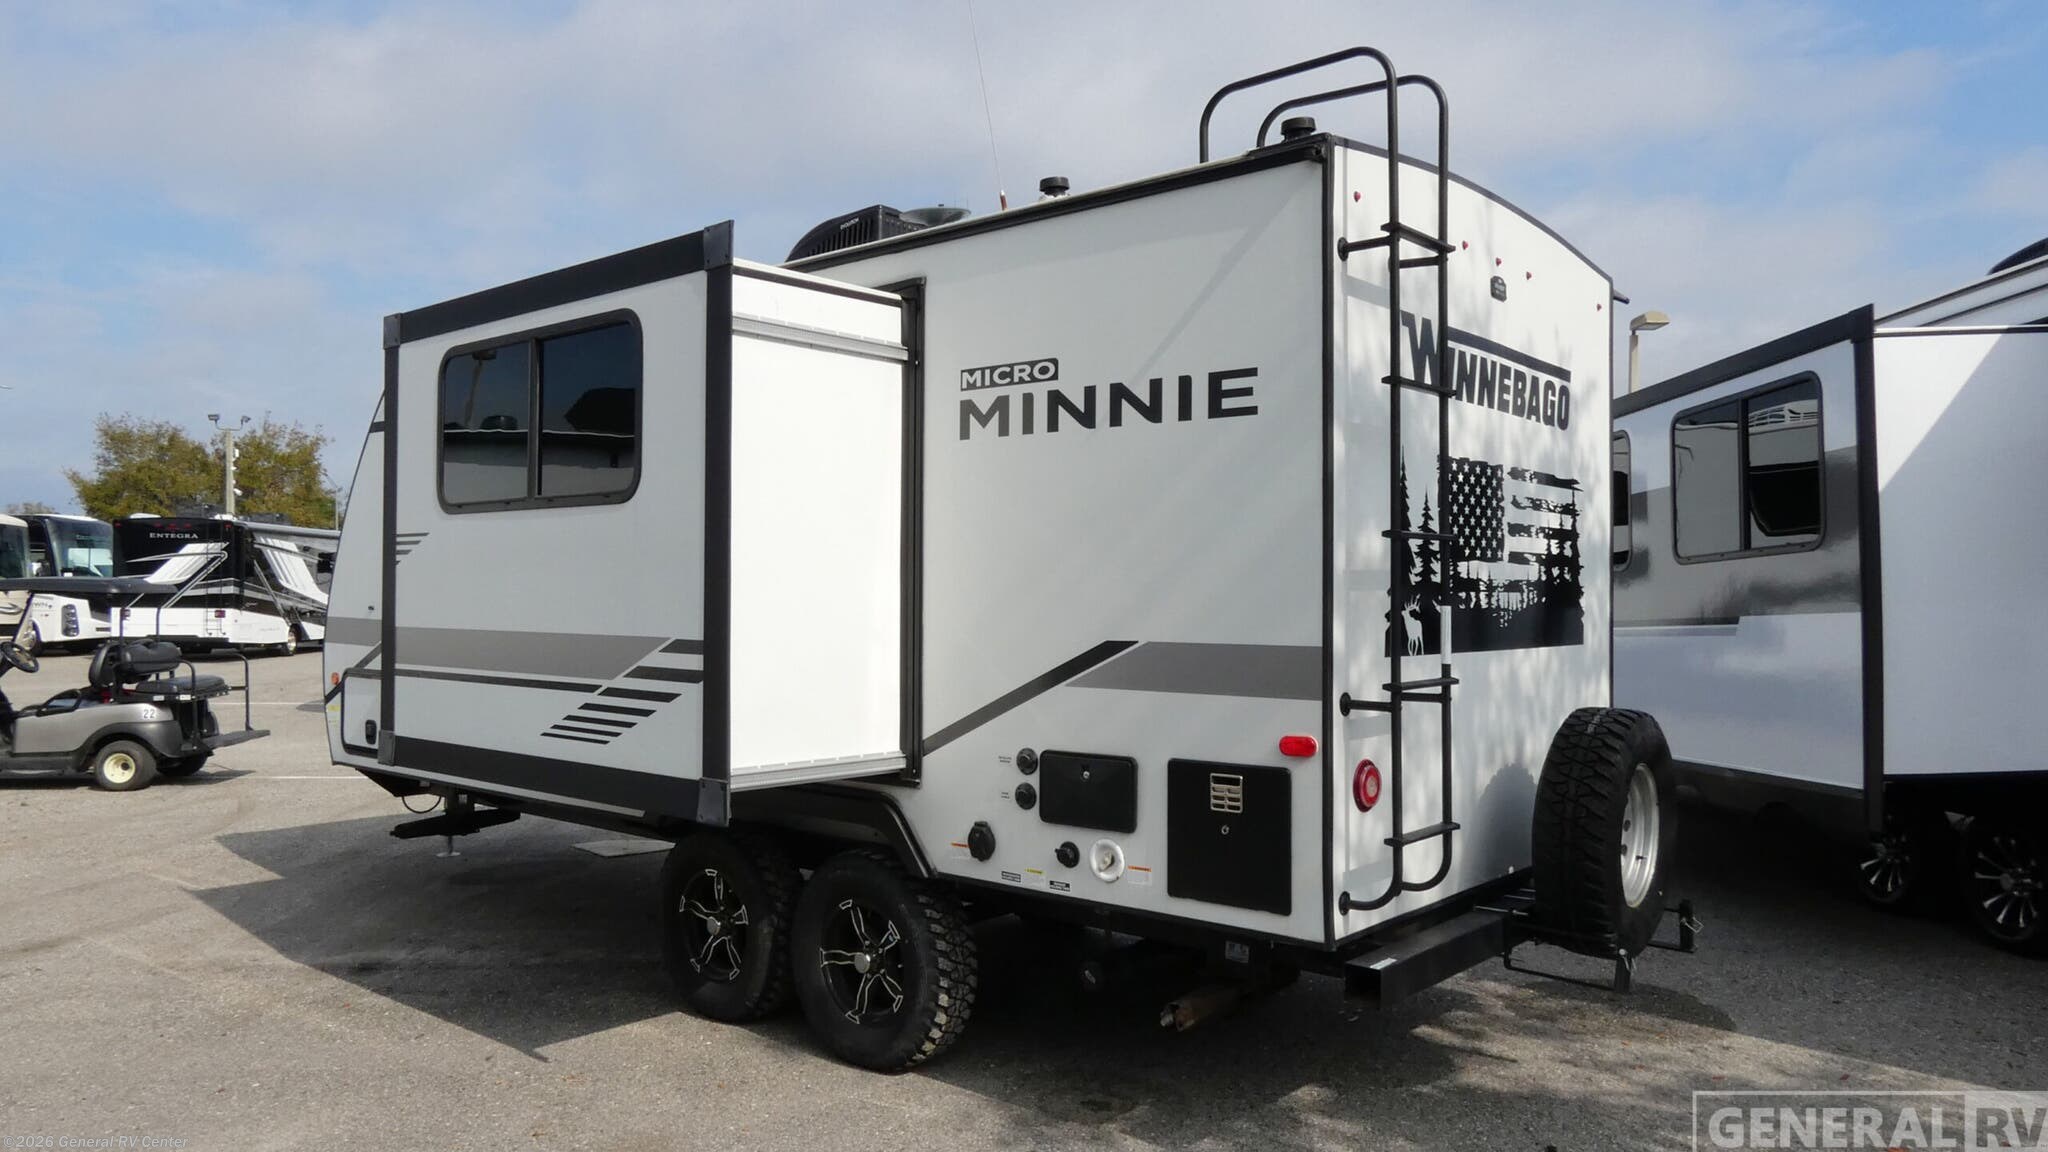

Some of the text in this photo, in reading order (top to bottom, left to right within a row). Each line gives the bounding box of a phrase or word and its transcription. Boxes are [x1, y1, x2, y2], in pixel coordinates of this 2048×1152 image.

[961, 360, 1056, 390] MICRO
[1400, 310, 1570, 431] WINNEBAGO
[960, 367, 1258, 441] MINNIE
[143, 709, 155, 719] 22
